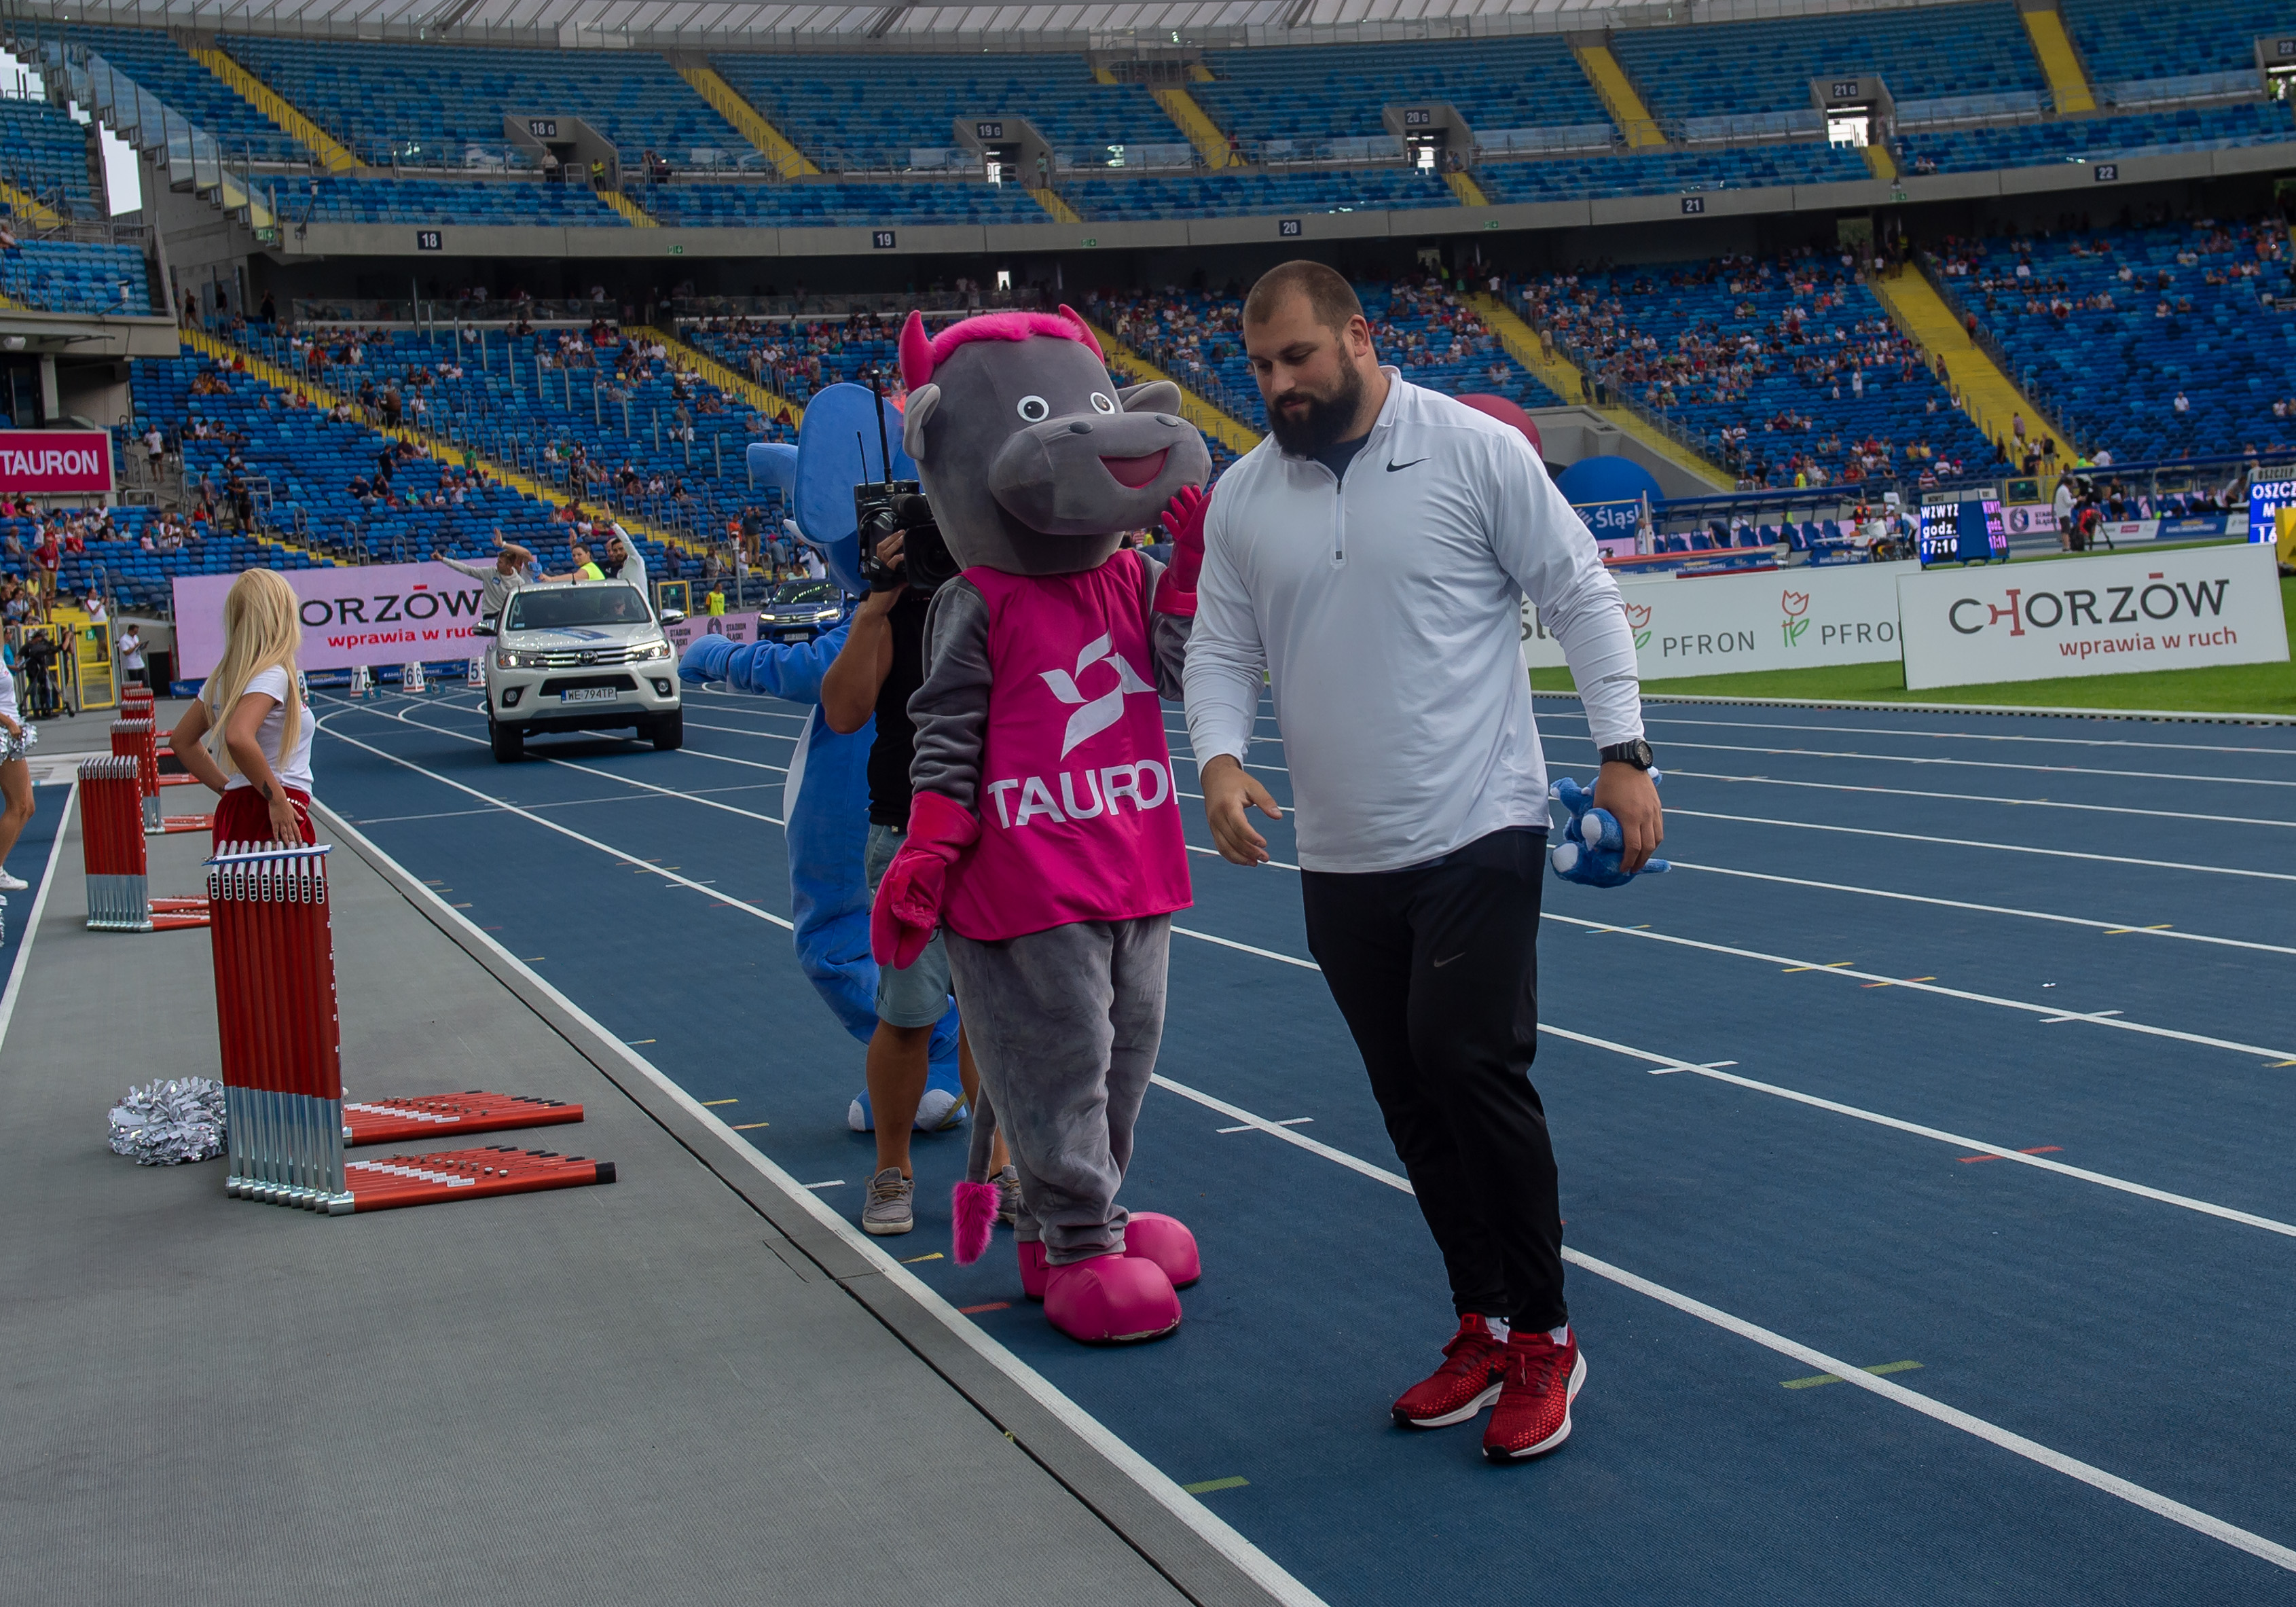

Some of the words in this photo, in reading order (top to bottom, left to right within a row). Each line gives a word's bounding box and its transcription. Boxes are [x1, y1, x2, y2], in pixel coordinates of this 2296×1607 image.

[1834, 84, 1847, 95] 21
[1407, 112, 1419, 122] 20
[532, 122, 545, 134] 18
[979, 125, 991, 136] 19
[2099, 167, 2114, 179] 22
[1686, 199, 1700, 211] 21
[1283, 222, 1297, 234] 20
[422, 233, 437, 247] 18
[877, 234, 891, 246] 19
[0, 450, 99, 475] TAURON
[1921, 539, 1957, 554] 17:10
[327, 629, 416, 649] wprawia
[422, 629, 439, 640] w
[446, 626, 477, 639] ruc
[1662, 630, 1755, 657] PFRON
[2059, 633, 2155, 660] wprawia
[2162, 633, 2181, 649] w
[2188, 626, 2238, 647] ruch
[406, 668, 414, 685] 6
[416, 667, 422, 684] 6
[471, 663, 479, 679] 5
[353, 672, 361, 690] 7
[568, 690, 581, 700] WE
[584, 688, 614, 700] 794TP
[987, 757, 1179, 829] TAURO
